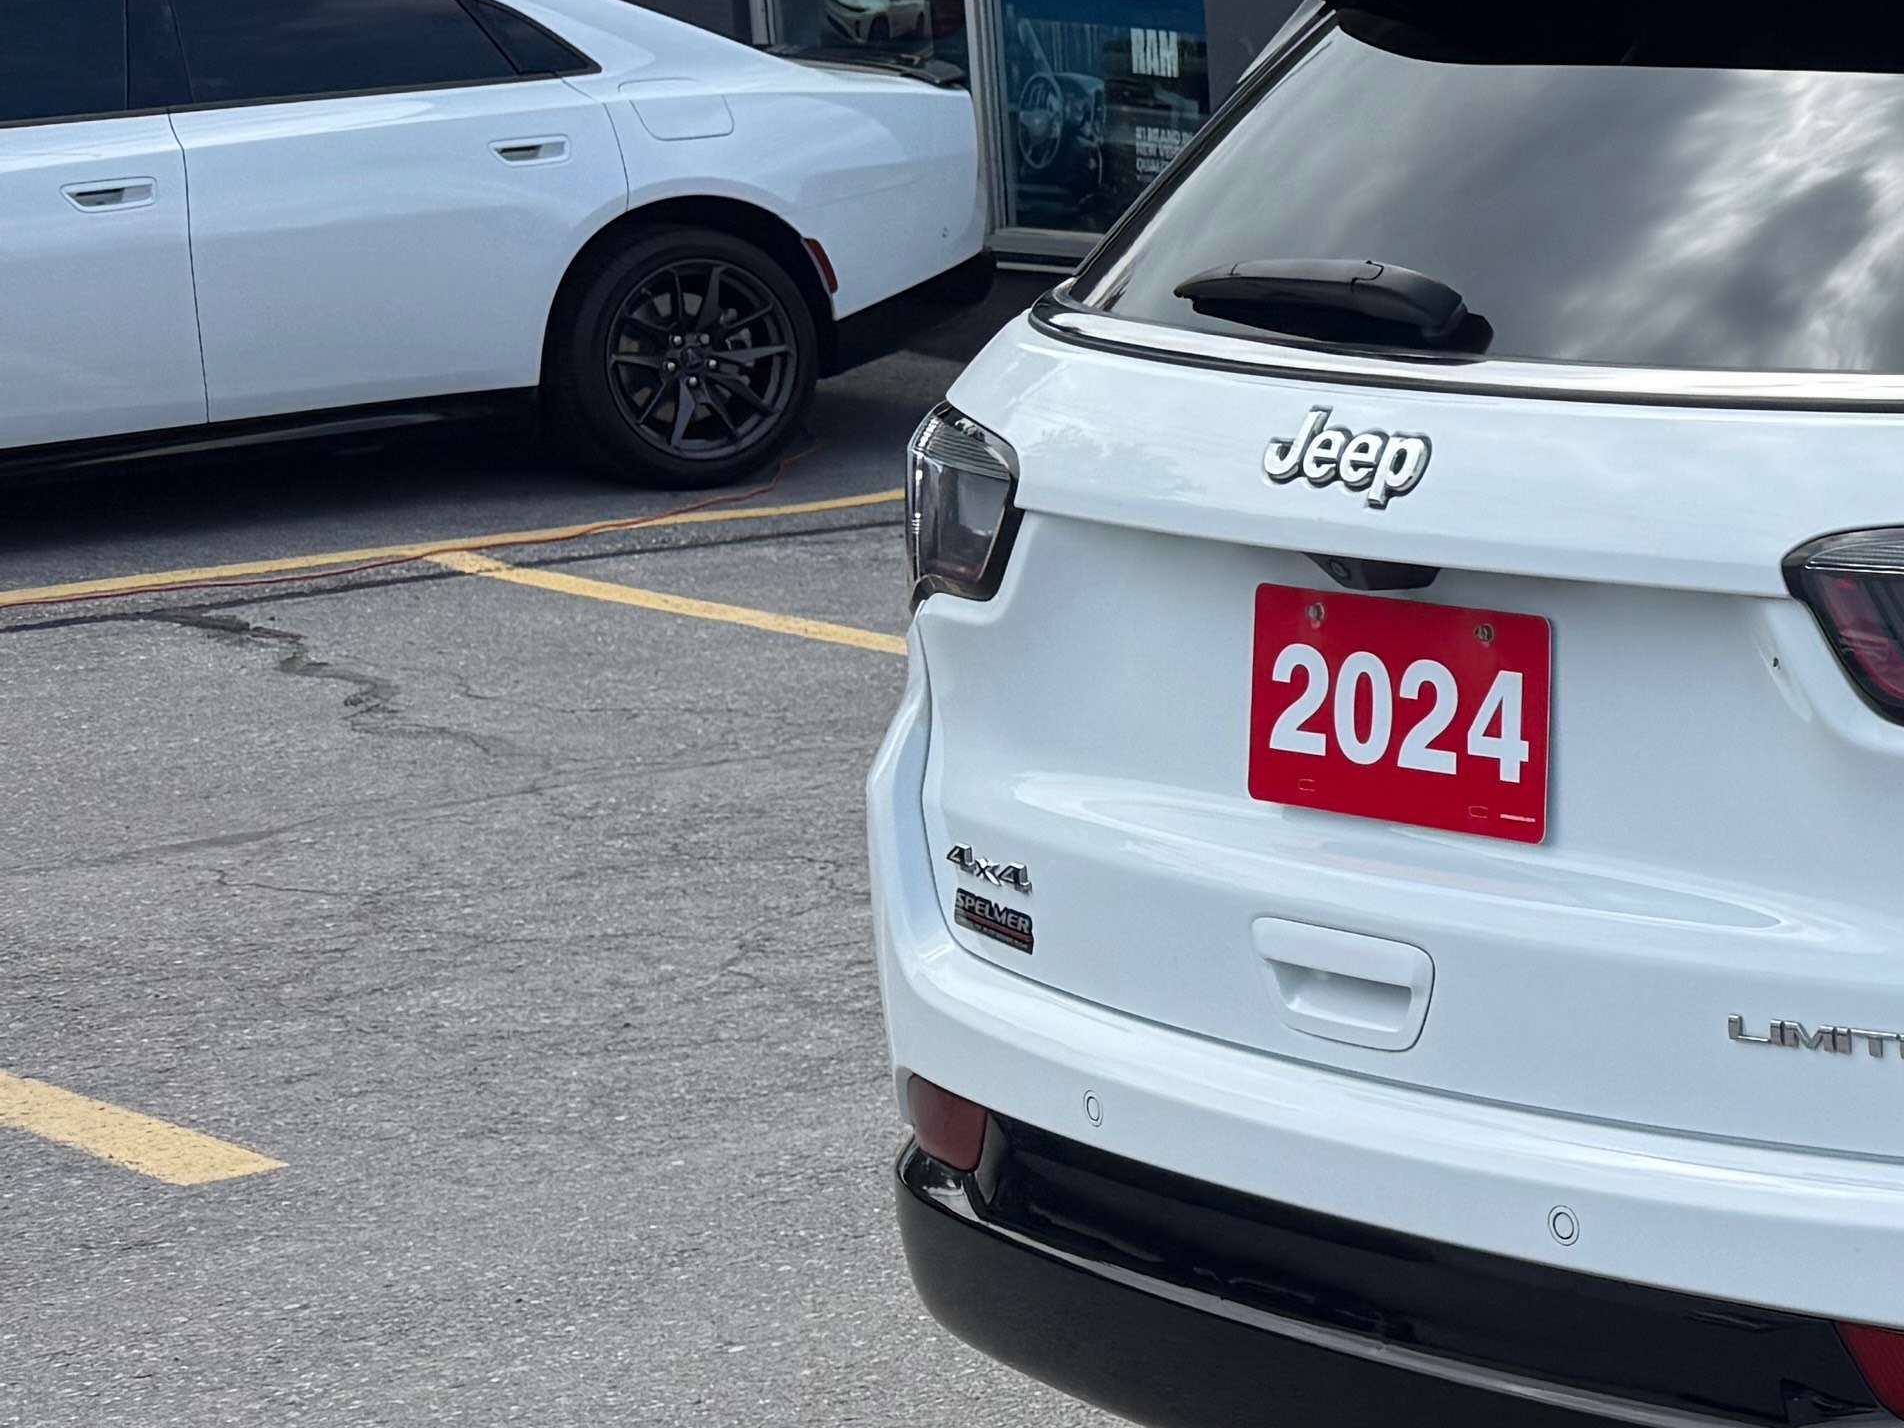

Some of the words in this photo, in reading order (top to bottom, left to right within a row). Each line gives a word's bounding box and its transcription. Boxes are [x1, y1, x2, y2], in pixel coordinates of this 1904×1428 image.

[1130, 28, 1178, 79] RAM
[1262, 405, 1433, 510] Jeep
[1268, 643, 1530, 784] 2024
[956, 891, 1031, 935] SPELMER
